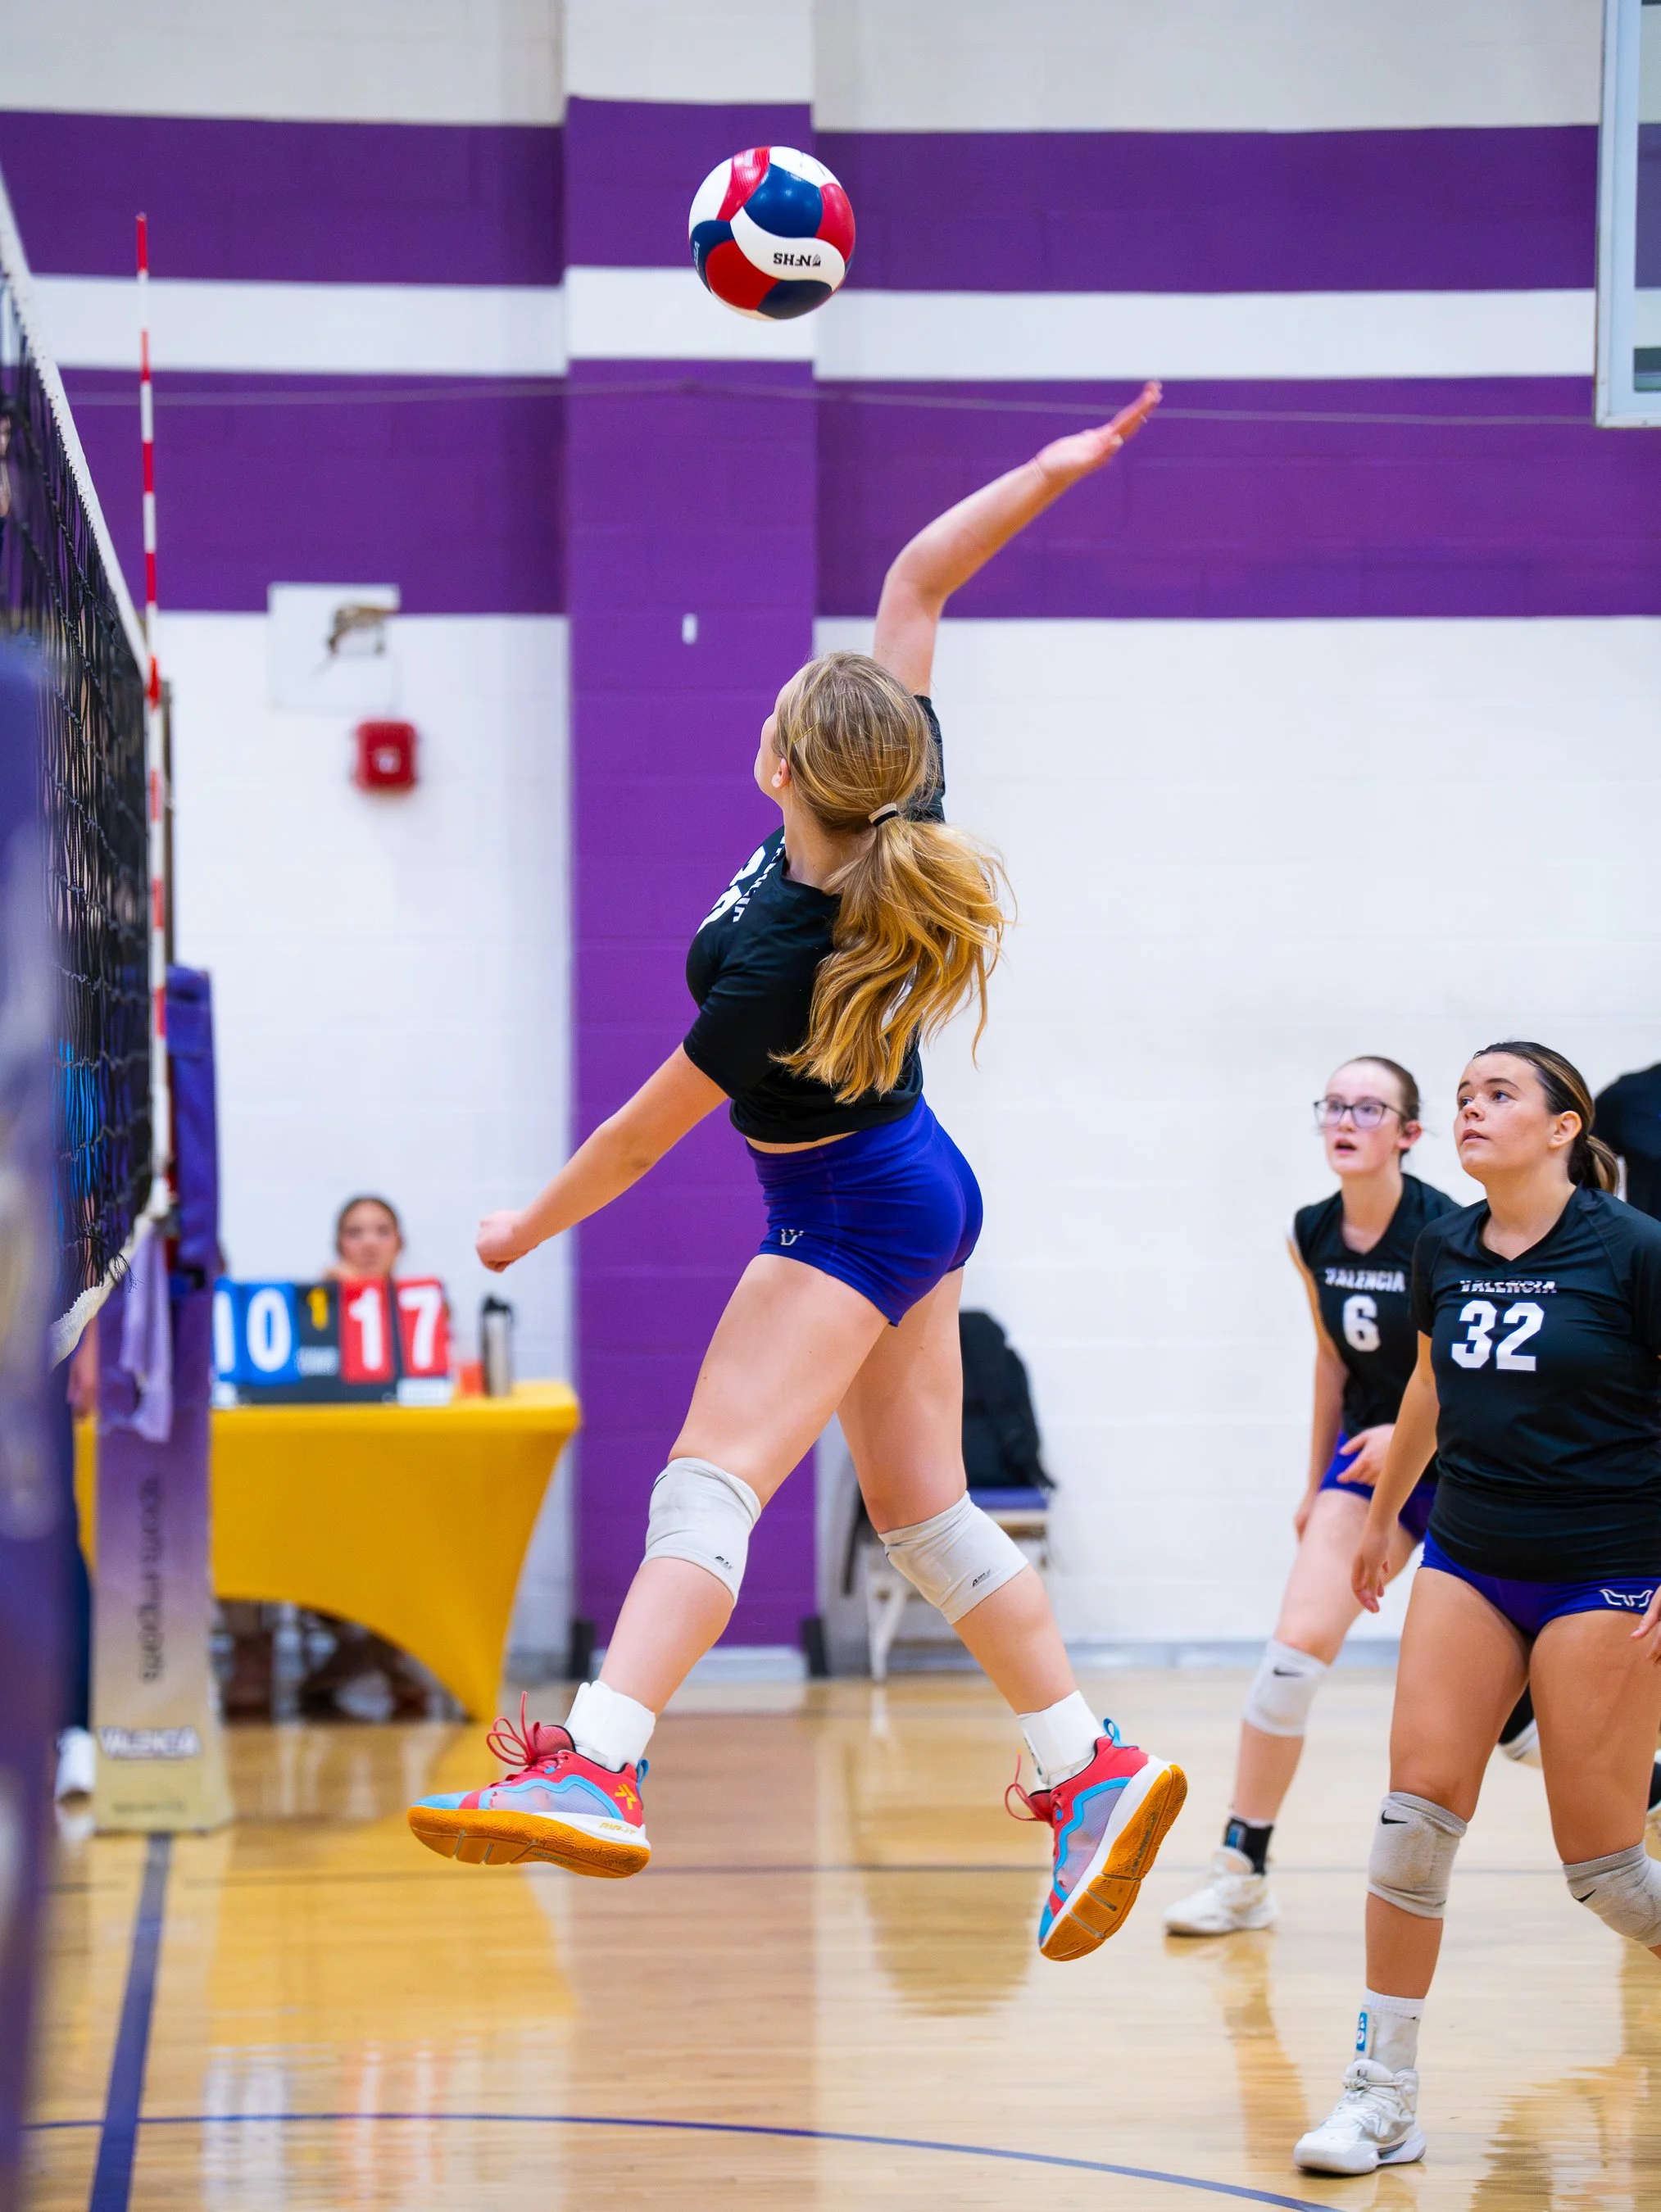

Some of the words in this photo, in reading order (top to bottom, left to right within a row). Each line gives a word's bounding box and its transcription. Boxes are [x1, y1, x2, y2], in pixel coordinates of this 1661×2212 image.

[773, 252, 811, 266] NFHS
[1324, 1267, 1405, 1292] VALENCIA
[1459, 1280, 1557, 1294] VALENCIA
[307, 1287, 328, 1330] 1
[349, 1284, 442, 1371] 17
[1343, 1294, 1381, 1352] 6
[1451, 1299, 1545, 1371] 32
